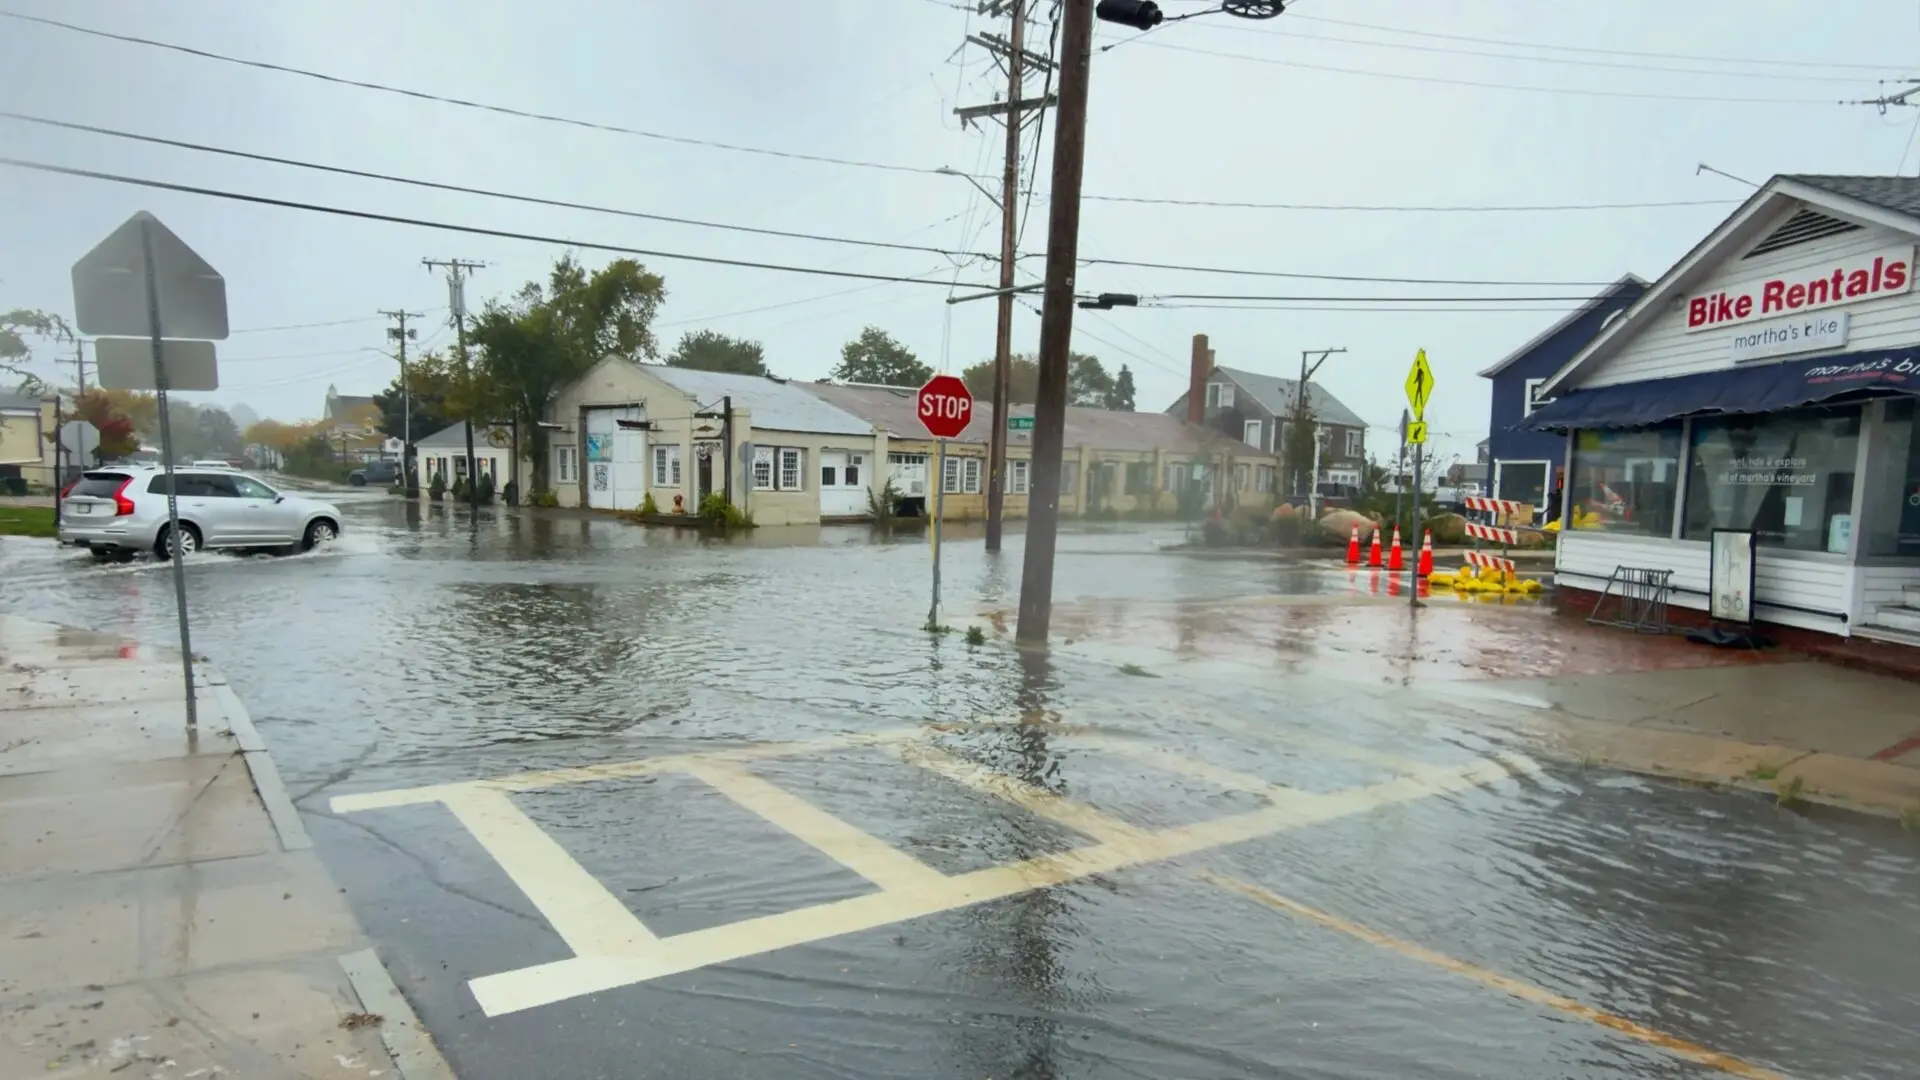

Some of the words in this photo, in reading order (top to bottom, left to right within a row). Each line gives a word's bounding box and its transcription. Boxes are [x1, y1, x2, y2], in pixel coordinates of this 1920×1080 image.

[1688, 293, 1753, 328] Bike
[1762, 256, 1907, 314] Rentals
[1734, 324, 1799, 349] martha's
[921, 393, 969, 420] STOP
[1729, 472, 1738, 481] of
[1738, 472, 1775, 482] martha's
[1777, 472, 1816, 484] vineyard
